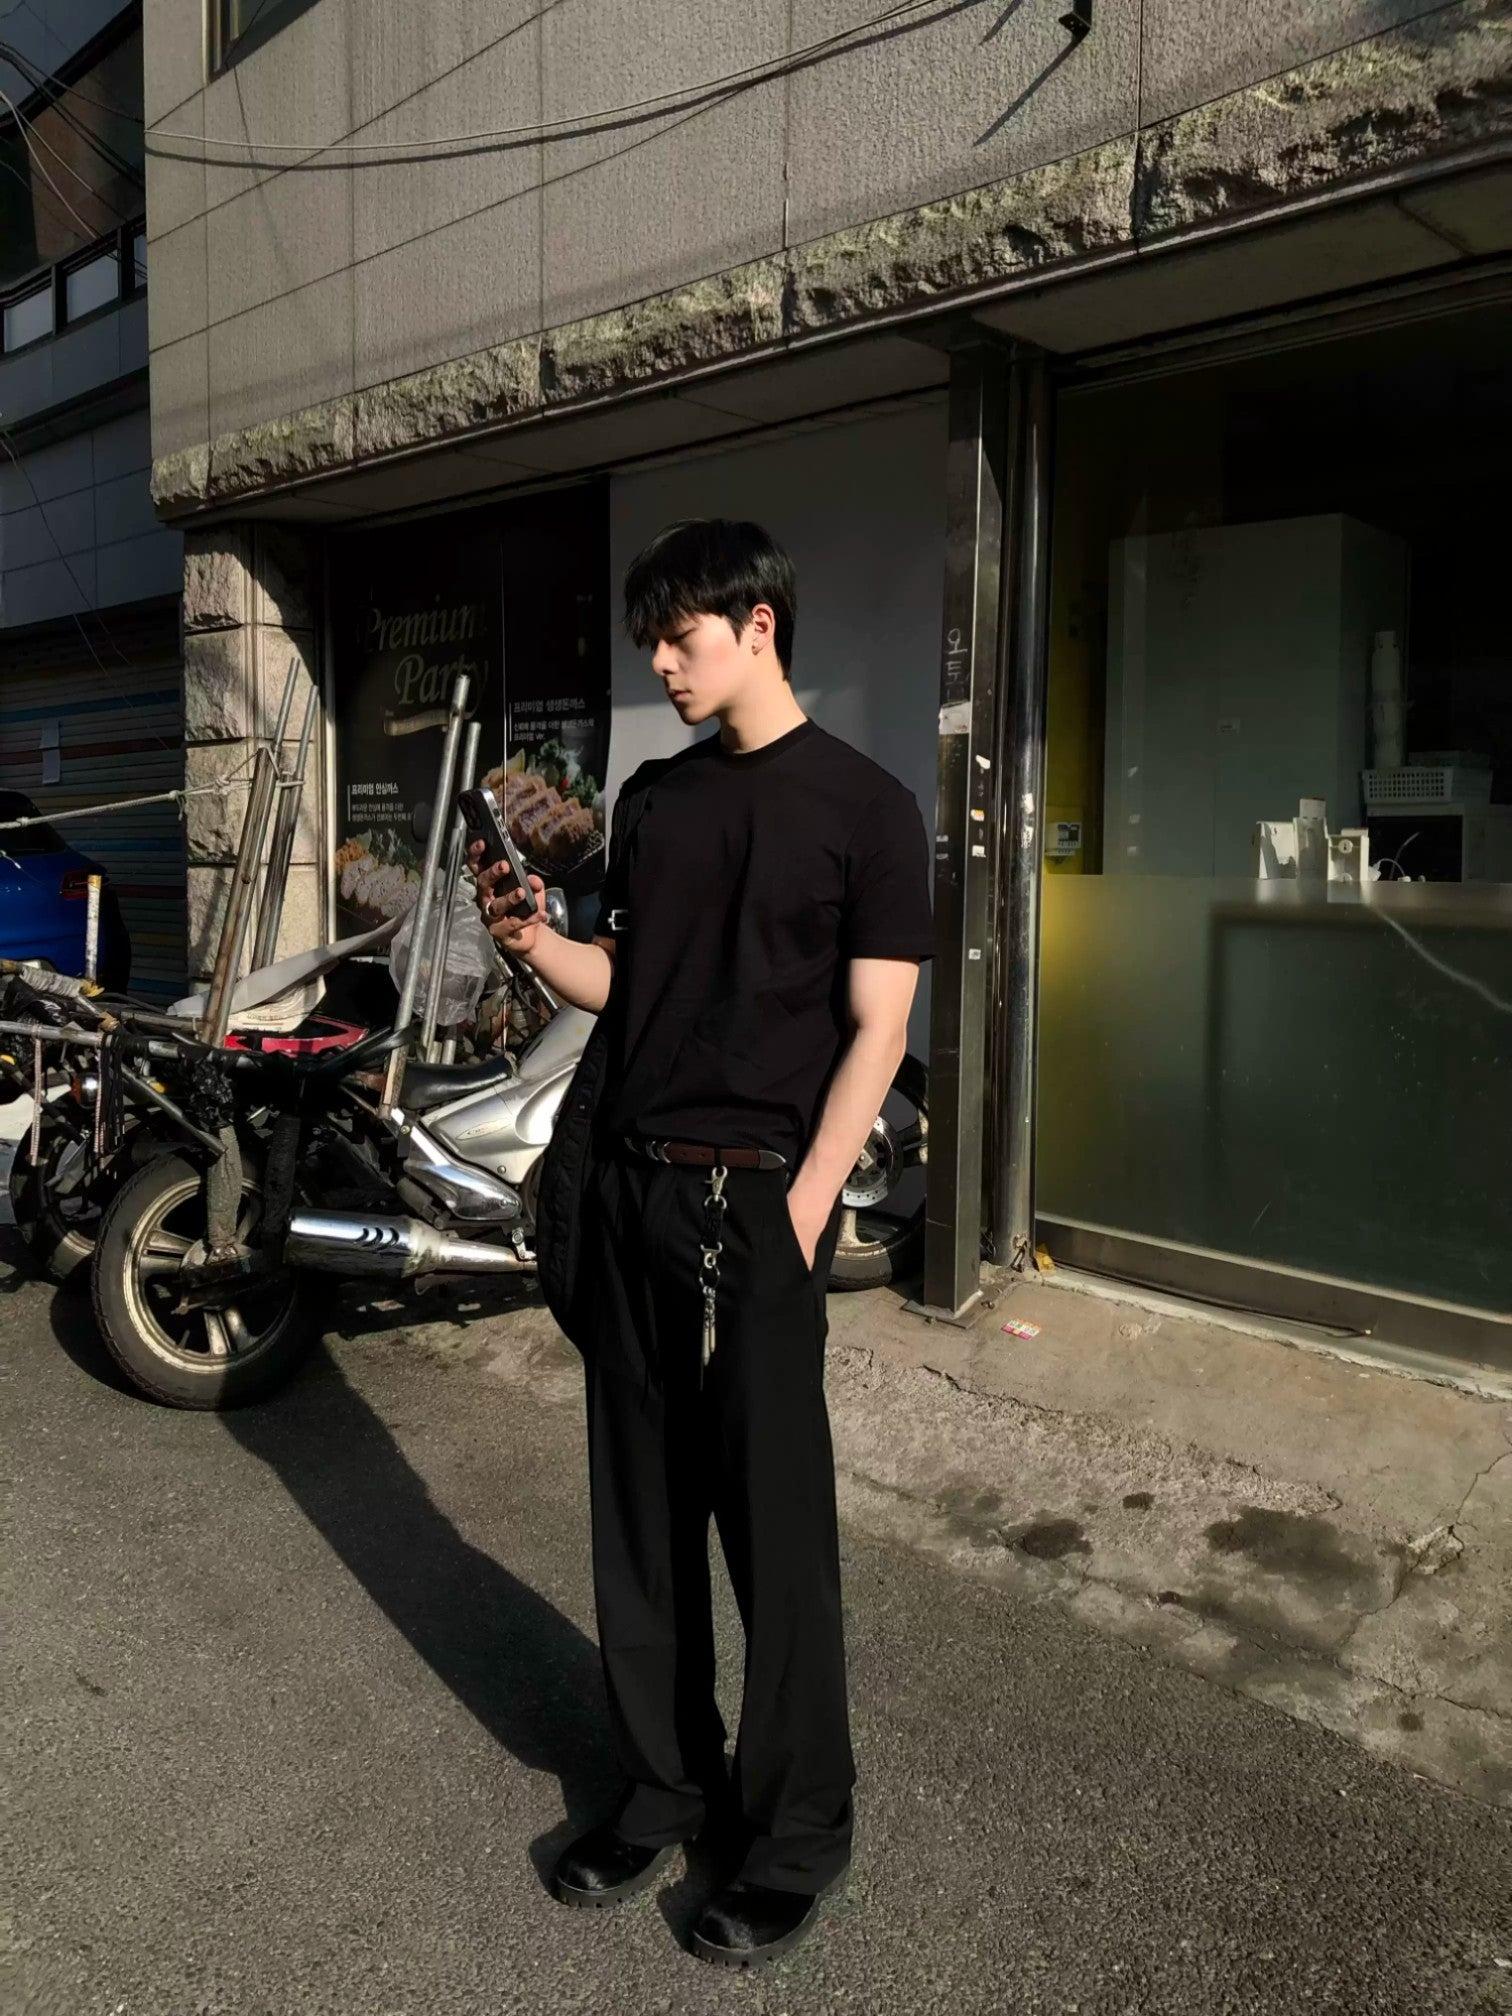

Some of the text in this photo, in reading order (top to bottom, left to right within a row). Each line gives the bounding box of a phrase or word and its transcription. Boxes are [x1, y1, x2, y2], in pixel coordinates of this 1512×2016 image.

[513, 699, 544, 713] 프리미엄
[351, 782, 399, 795] 프리미엄 안심까스
